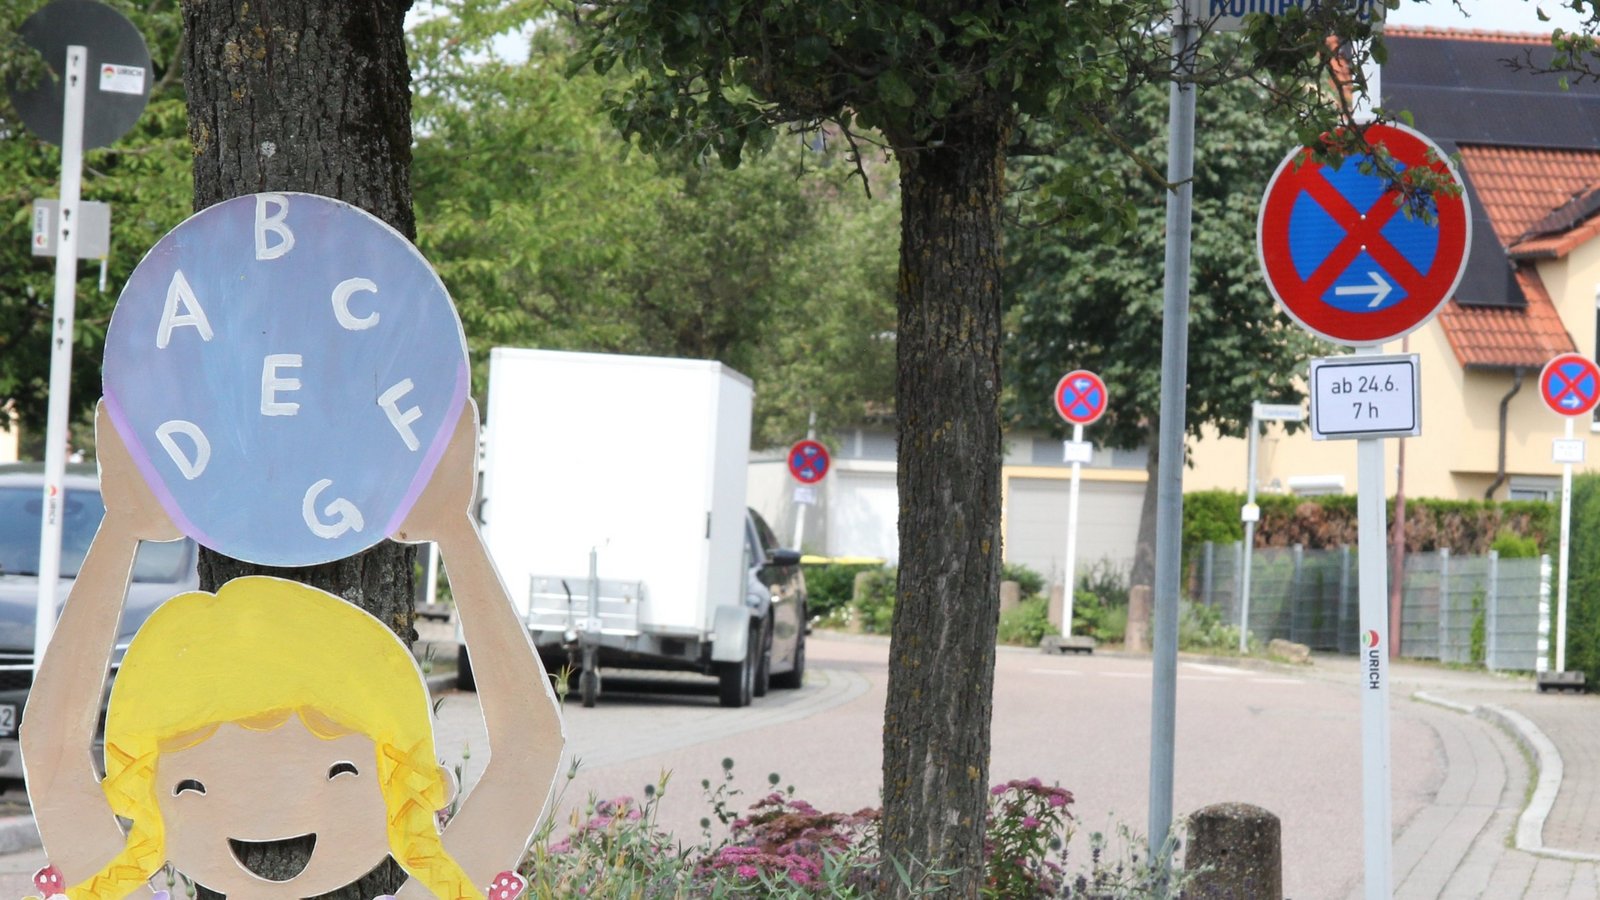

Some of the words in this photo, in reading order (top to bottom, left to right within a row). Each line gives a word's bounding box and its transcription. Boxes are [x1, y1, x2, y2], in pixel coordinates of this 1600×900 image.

[255, 194, 295, 260] B
[156, 269, 214, 349] A
[331, 277, 380, 331] C
[260, 354, 302, 416] E
[1331, 377, 1352, 394] ab
[1358, 374, 1399, 393] 24.6.
[1353, 402, 1362, 419] 7
[1369, 402, 1379, 419] h
[377, 378, 423, 452] F
[155, 419, 211, 480] D
[302, 478, 365, 539] G
[1369, 650, 1380, 690] URICH
[0, 708, 12, 727] 2
